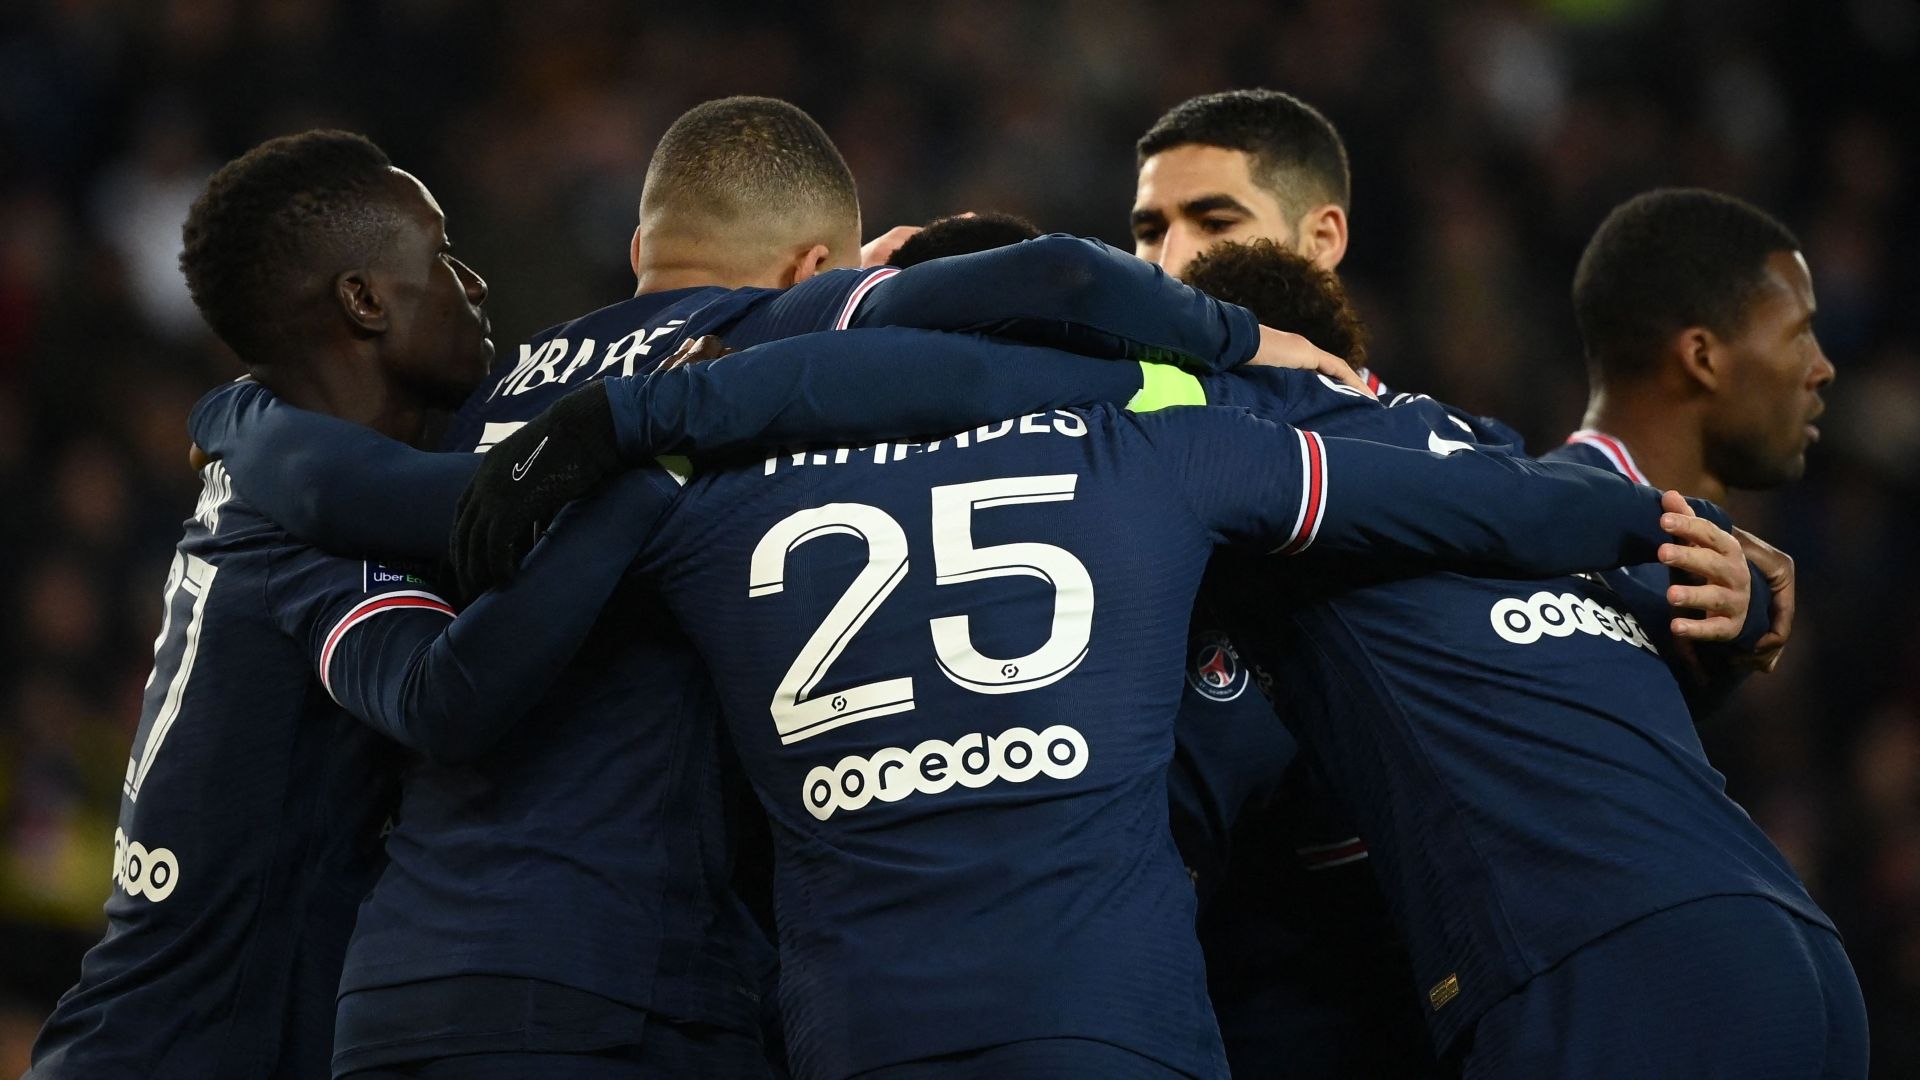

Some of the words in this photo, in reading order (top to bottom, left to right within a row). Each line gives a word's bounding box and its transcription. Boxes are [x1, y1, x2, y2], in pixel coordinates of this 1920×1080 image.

[373, 572, 404, 582] Uber
[748, 473, 1095, 746] 25
[1497, 596, 1657, 650] oored
[805, 728, 1085, 815] ooredoo
